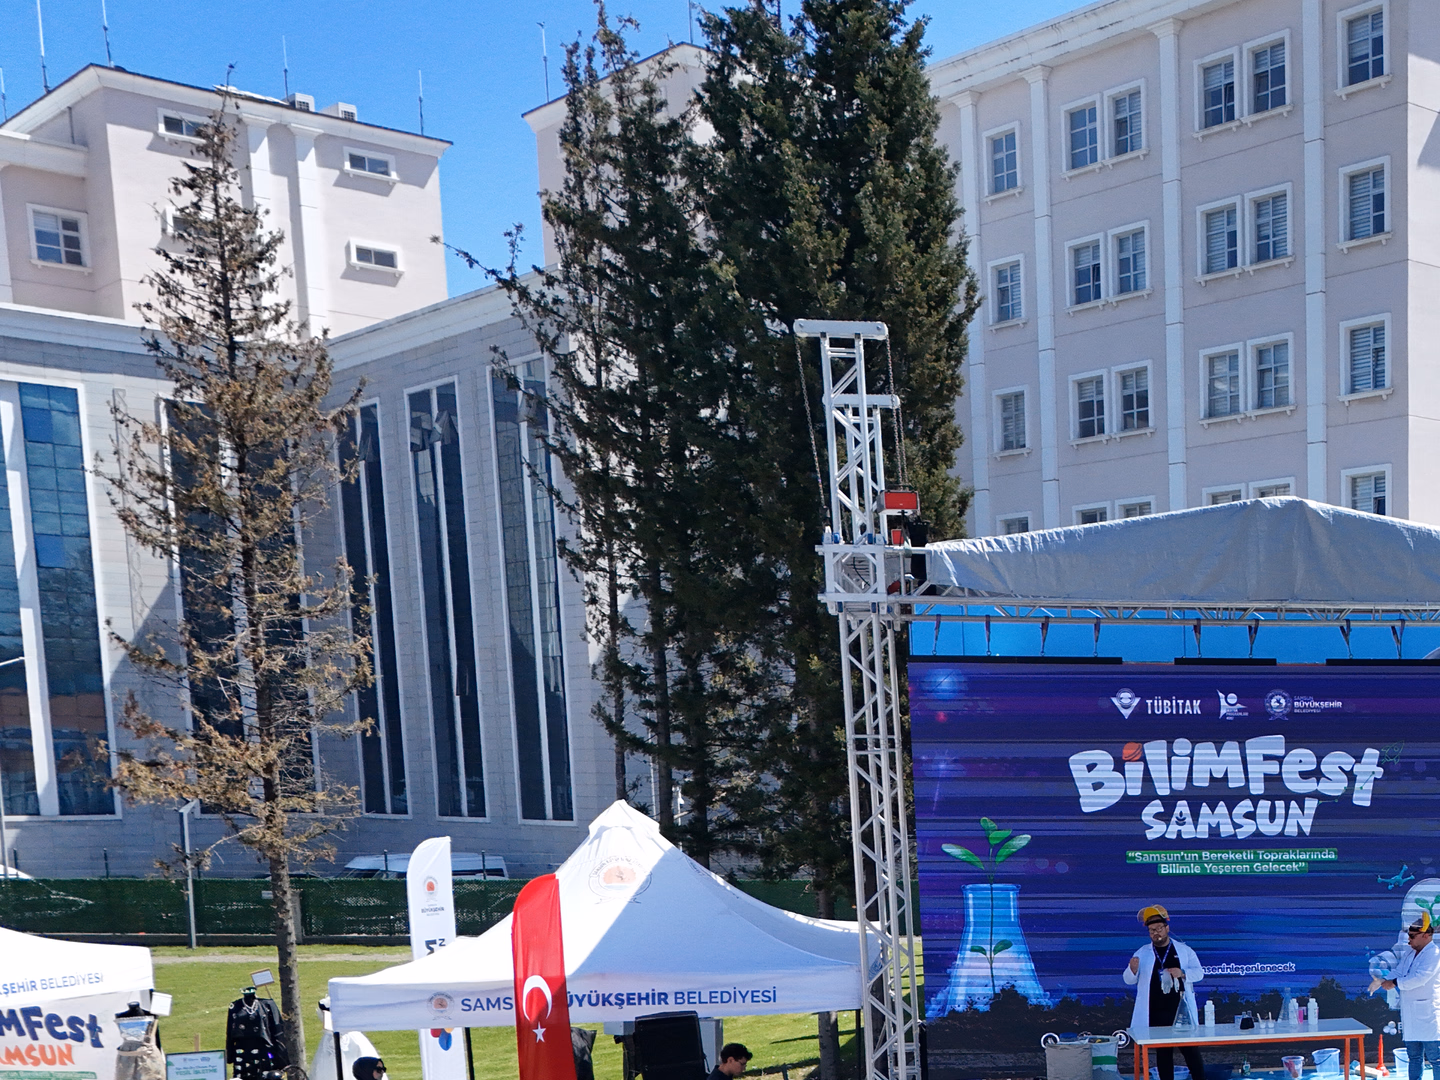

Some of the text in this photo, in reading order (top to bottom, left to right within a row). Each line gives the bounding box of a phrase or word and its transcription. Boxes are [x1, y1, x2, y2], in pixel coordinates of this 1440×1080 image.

[1145, 696, 1202, 715] TÜBİTAK
[1294, 700, 1343, 709] BÜYÜKŞEHİR
[1141, 797, 1320, 840] SAMSUN
[1201, 850, 1254, 861] Bereketli
[1256, 849, 1335, 861] Topraklarında
[1160, 863, 1201, 874] Bilimle
[1204, 862, 1251, 874] Yeşeren
[40, 972, 104, 990] BELEDİYESİ
[460, 985, 777, 1012] SAMS ÜYÜKŞEHİR BELEDİYESİ
